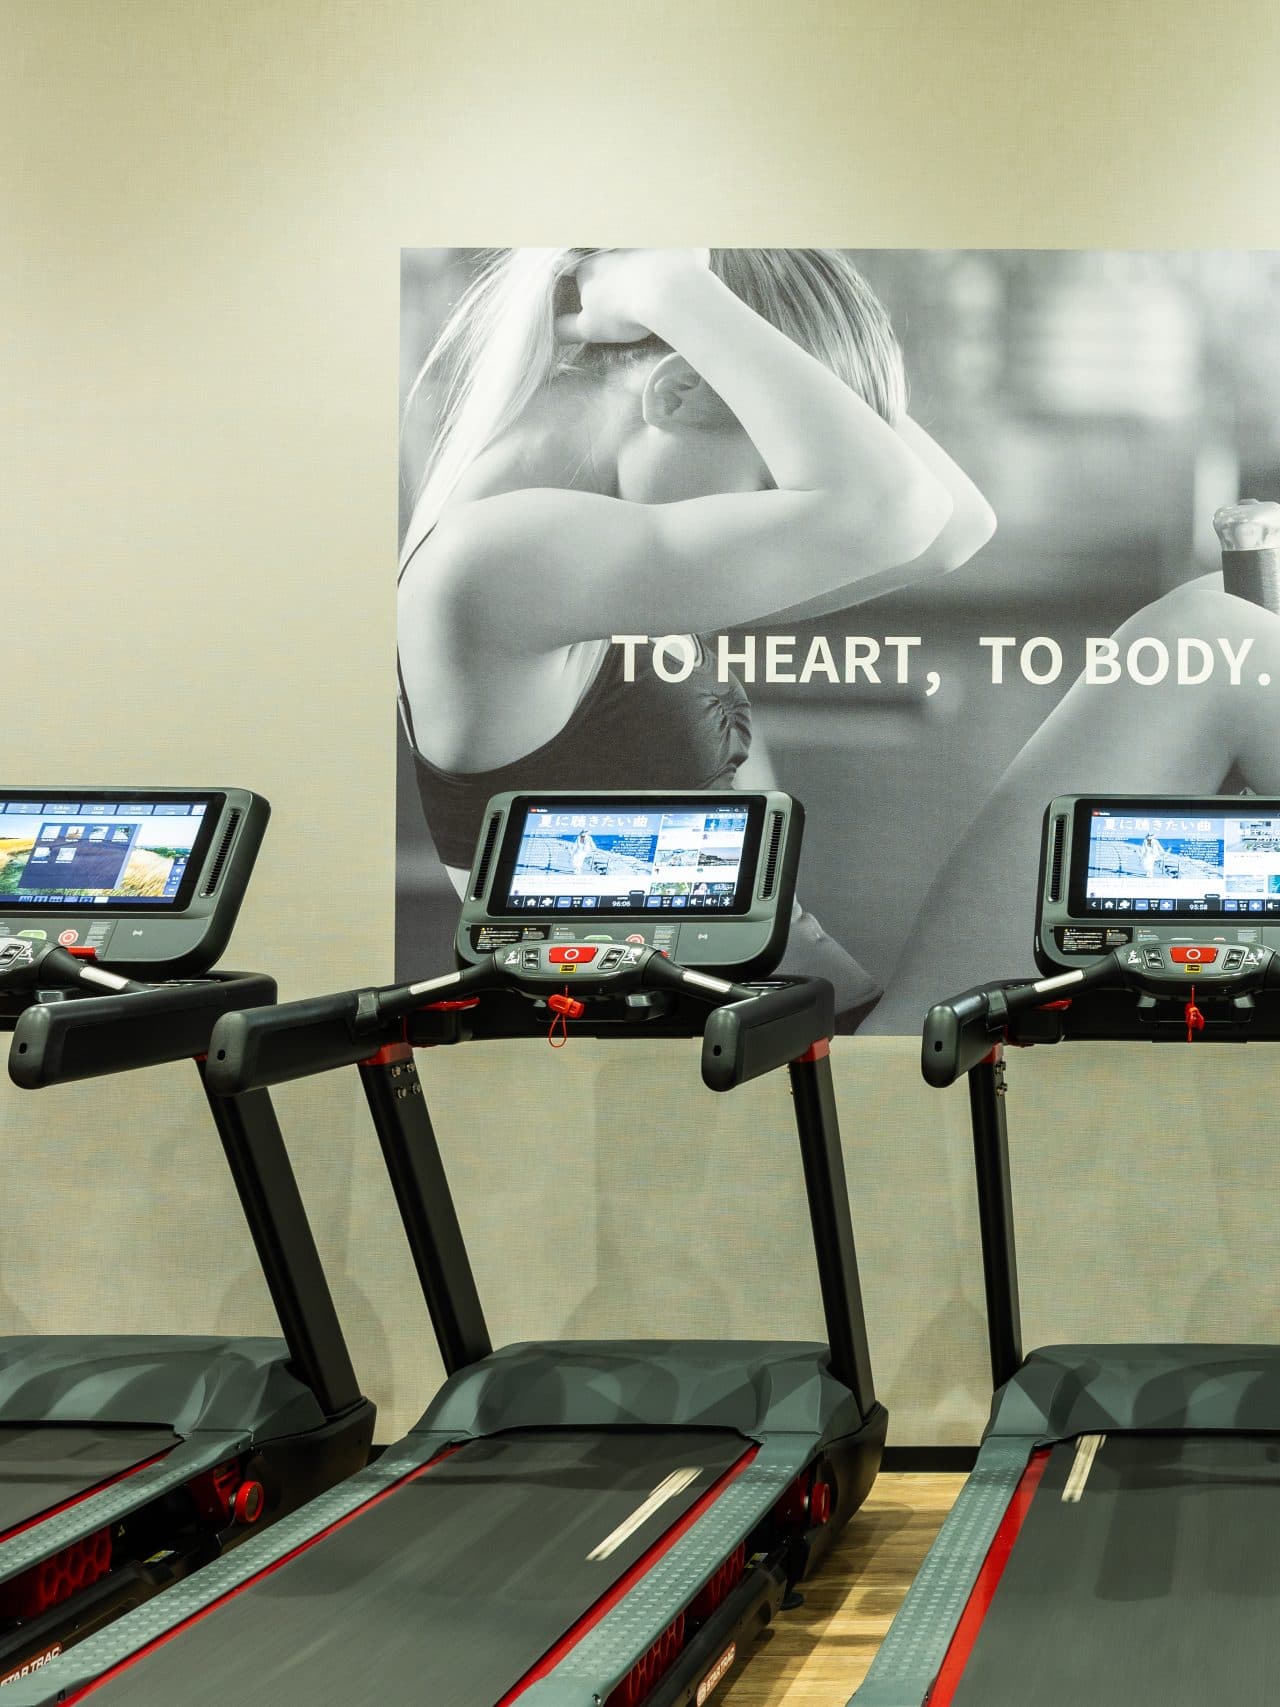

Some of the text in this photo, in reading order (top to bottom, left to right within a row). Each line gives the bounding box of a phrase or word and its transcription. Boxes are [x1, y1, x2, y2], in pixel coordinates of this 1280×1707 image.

[611, 634, 1272, 697] TO HEART, TO BODY.
